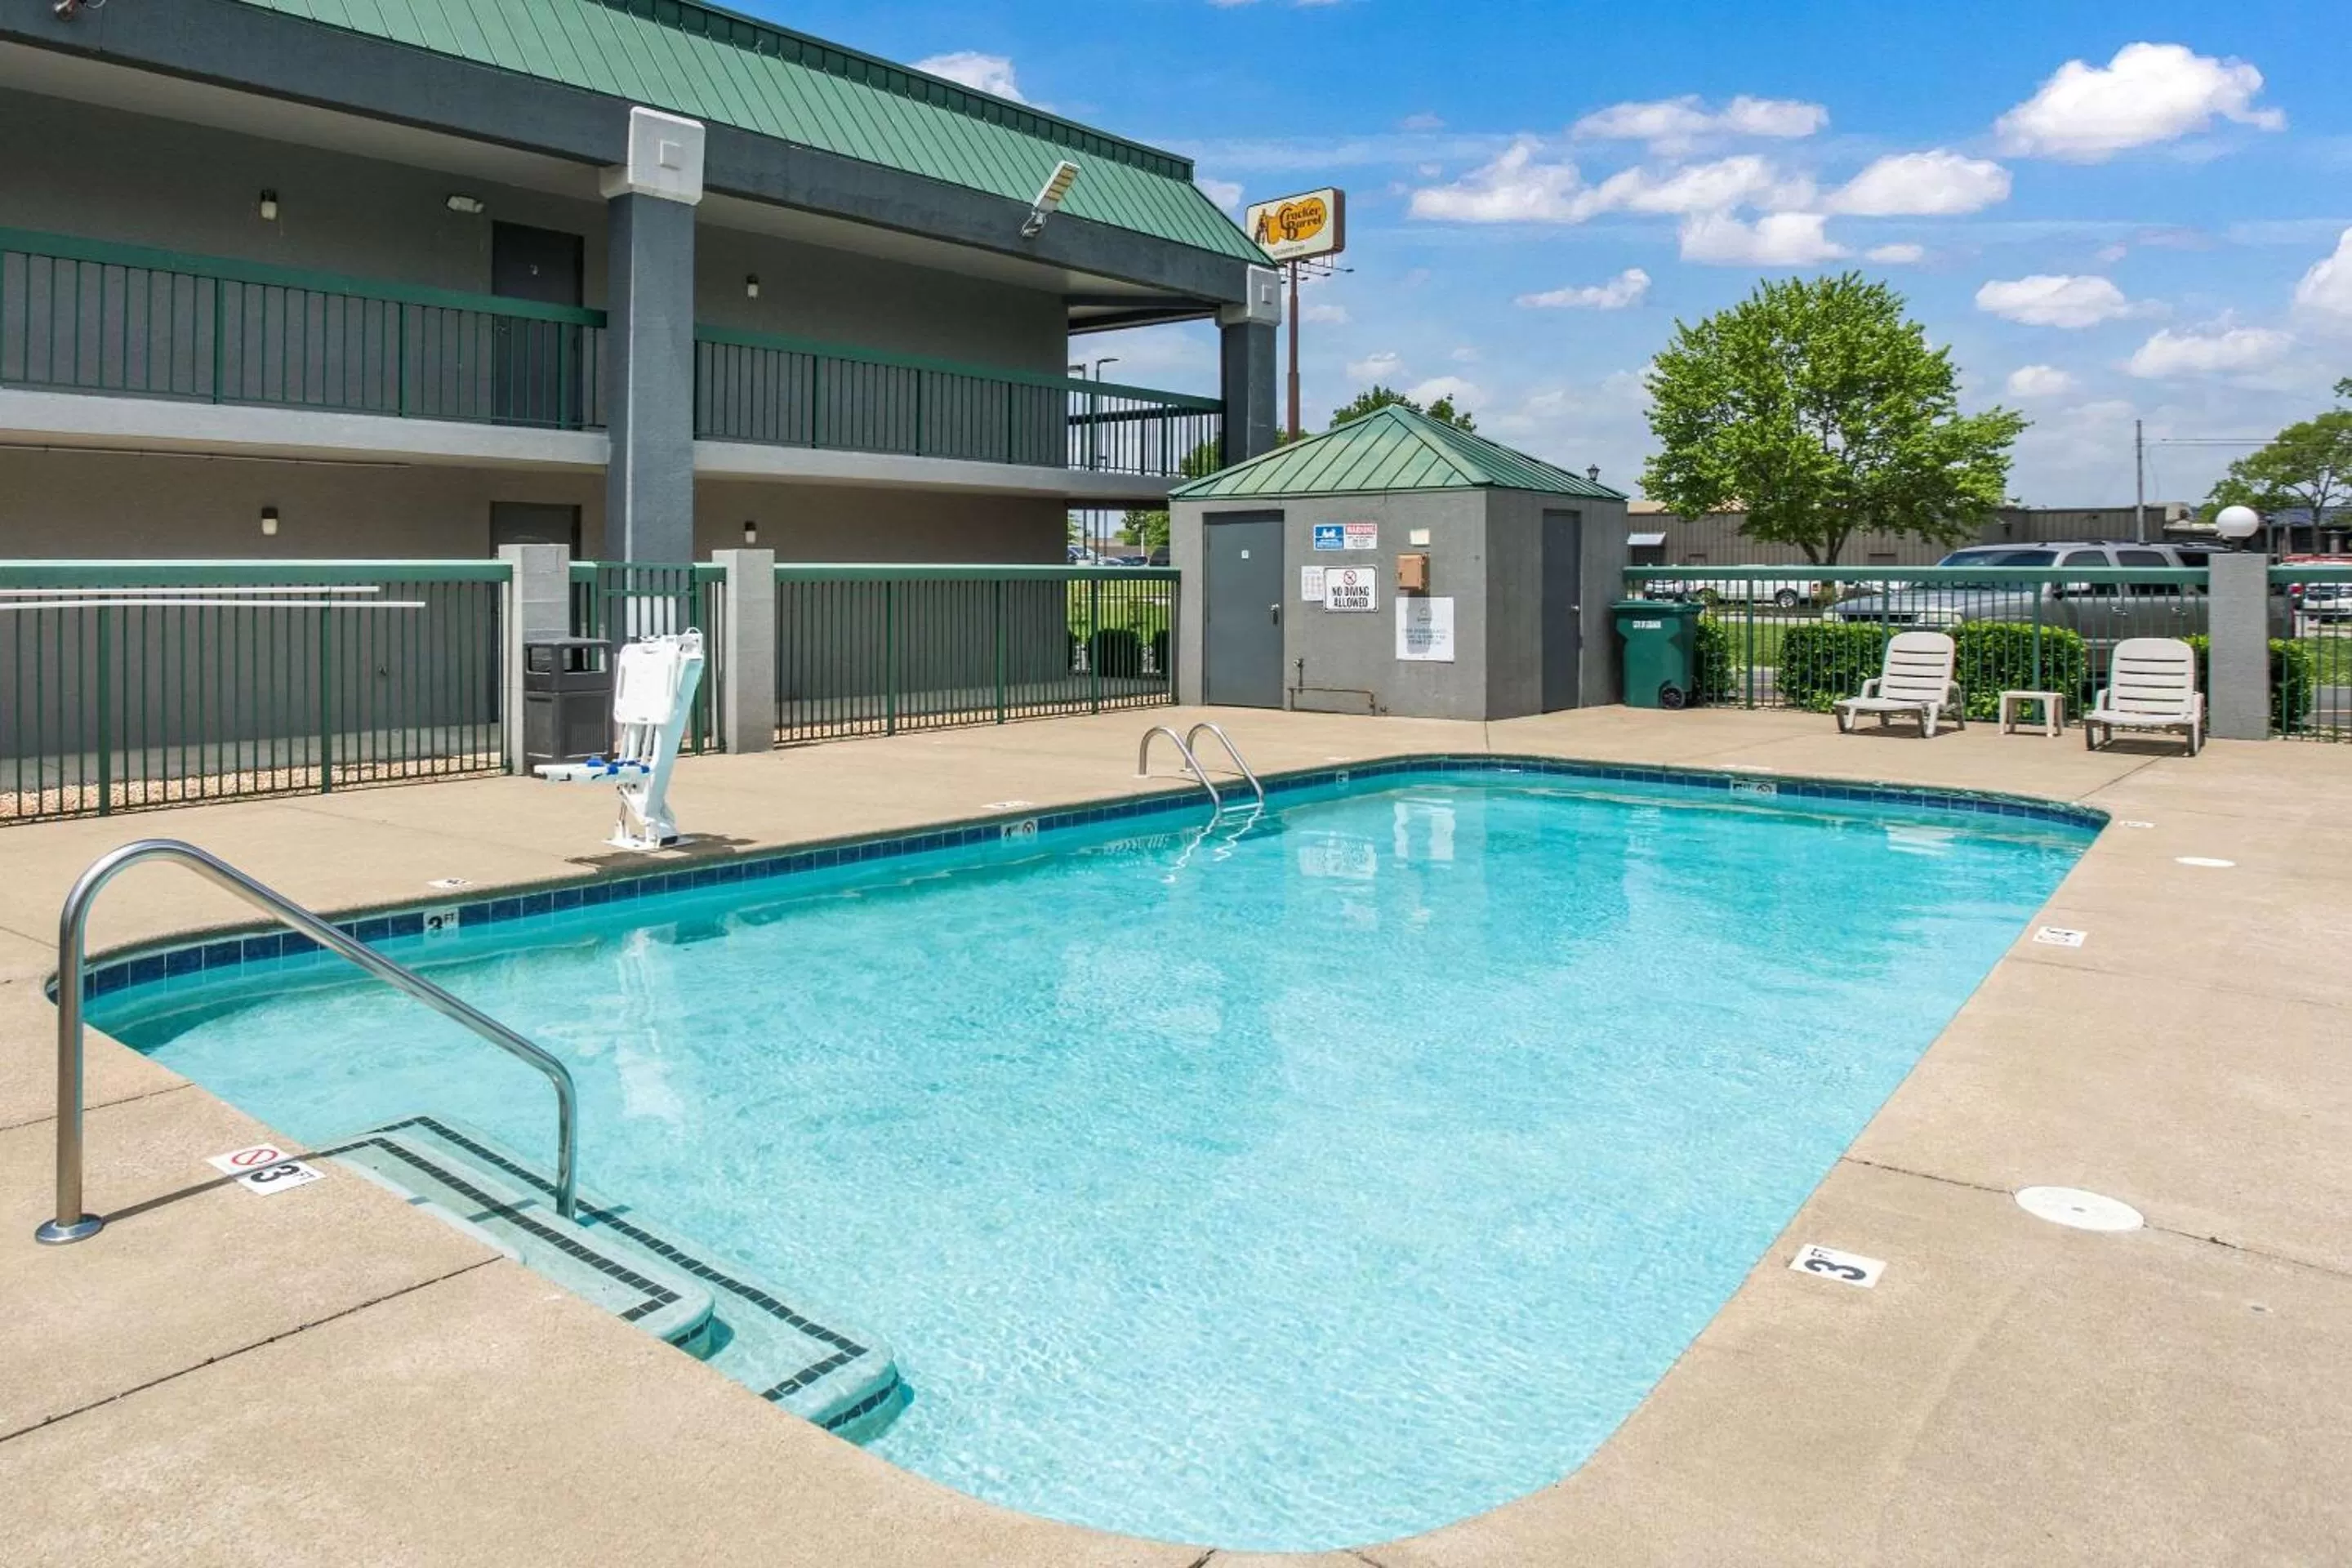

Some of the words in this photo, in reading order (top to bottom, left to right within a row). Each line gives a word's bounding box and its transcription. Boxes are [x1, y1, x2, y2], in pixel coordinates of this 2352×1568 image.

[1280, 206, 1321, 229] Cracker
[1332, 586, 1343, 596] NO
[1345, 586, 1370, 596] DIVING
[1334, 597, 1368, 608] ALLOWED
[250, 1164, 300, 1183] 3
[1803, 1258, 1867, 1281] 3
